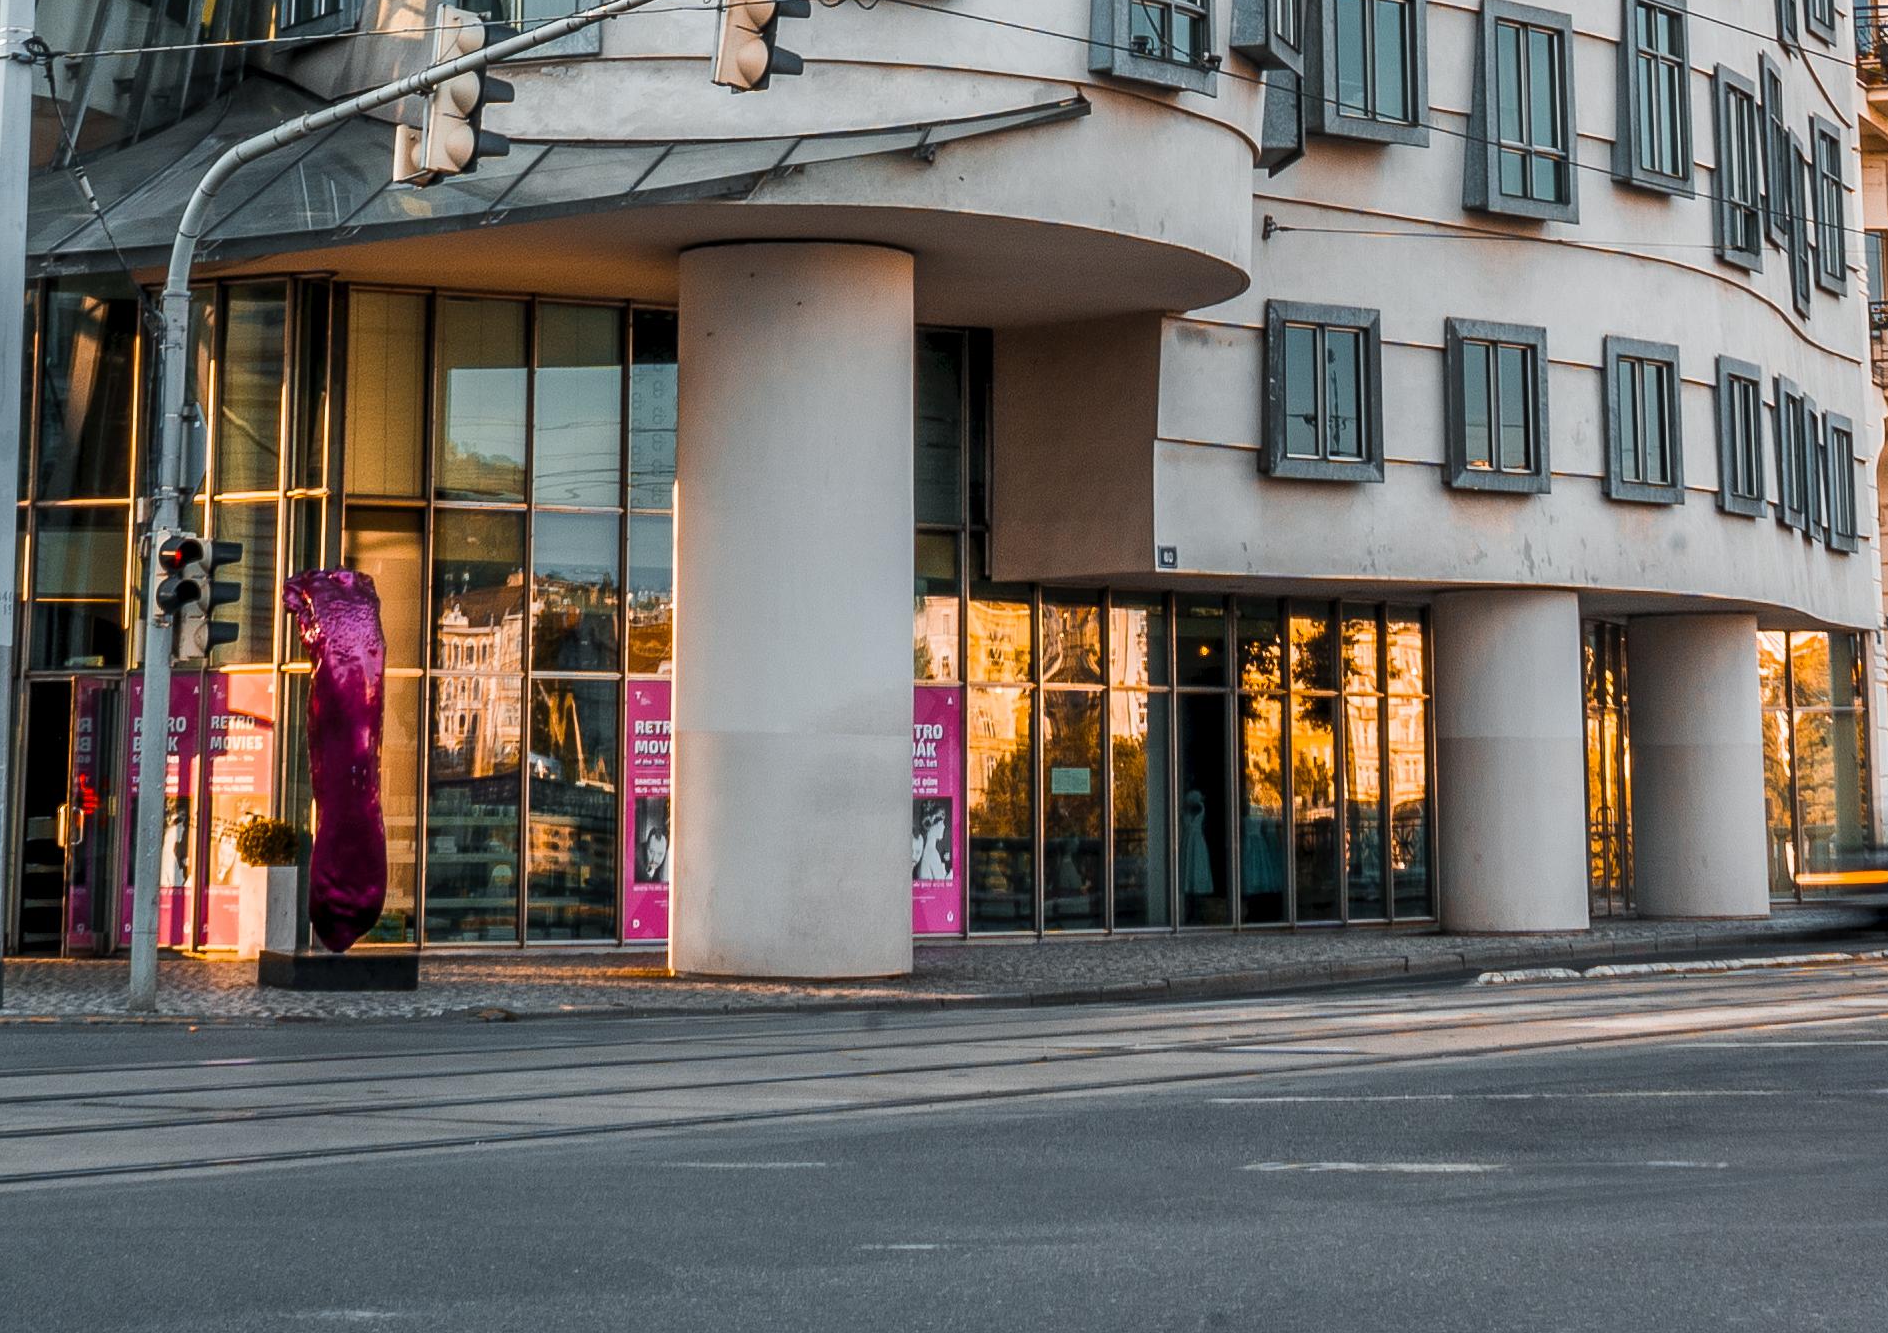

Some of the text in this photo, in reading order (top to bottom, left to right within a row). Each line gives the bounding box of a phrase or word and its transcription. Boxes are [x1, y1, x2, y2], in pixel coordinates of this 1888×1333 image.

[211, 715, 255, 730] RETRO
[635, 720, 671, 735] RETR
[914, 724, 943, 740] TRO
[210, 735, 263, 751] MOVIES
